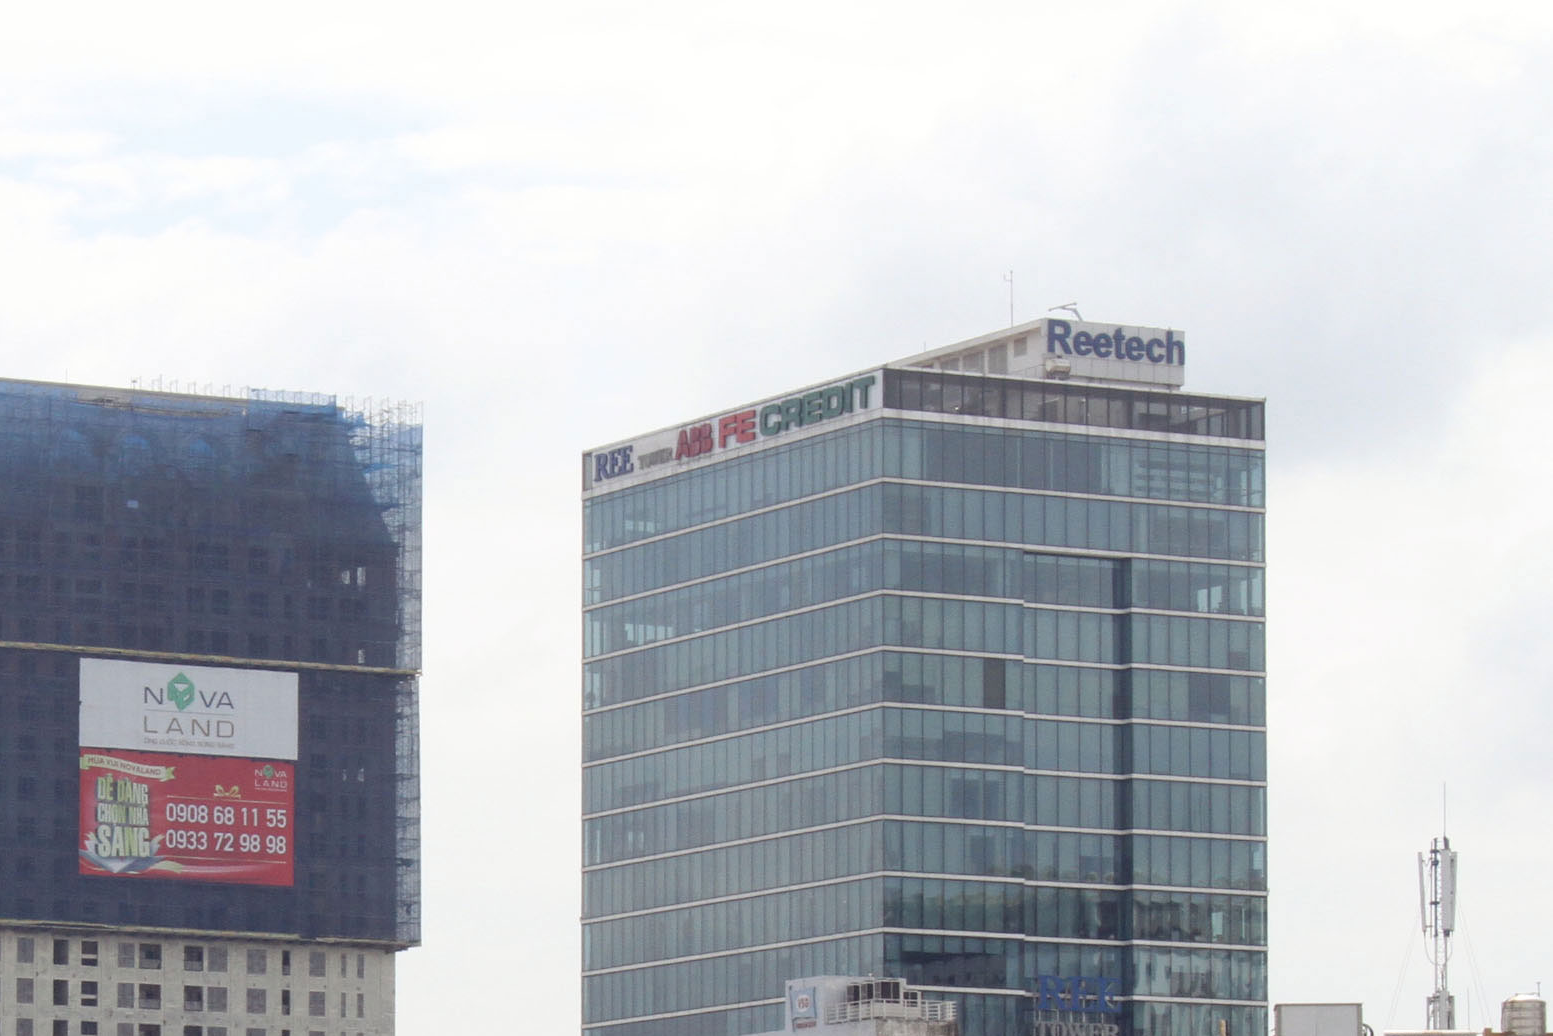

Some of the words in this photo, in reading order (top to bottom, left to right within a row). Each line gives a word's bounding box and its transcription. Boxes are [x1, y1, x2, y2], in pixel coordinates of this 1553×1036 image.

[1047, 319, 1185, 366] Reetech
[718, 409, 757, 449] FE
[760, 375, 875, 437] CREDIT
[675, 422, 714, 461] ABB
[594, 445, 635, 482] REE
[143, 715, 235, 738] LAND
[254, 779, 288, 789] LAND
[166, 803, 209, 824] 0908
[213, 806, 235, 825] 68
[241, 807, 258, 827] 11
[266, 809, 287, 828] 55
[166, 829, 208, 850] 0933
[213, 832, 234, 852] 72
[240, 834, 261, 853] 98
[266, 835, 286, 854] 98
[1038, 975, 1122, 1013] REE
